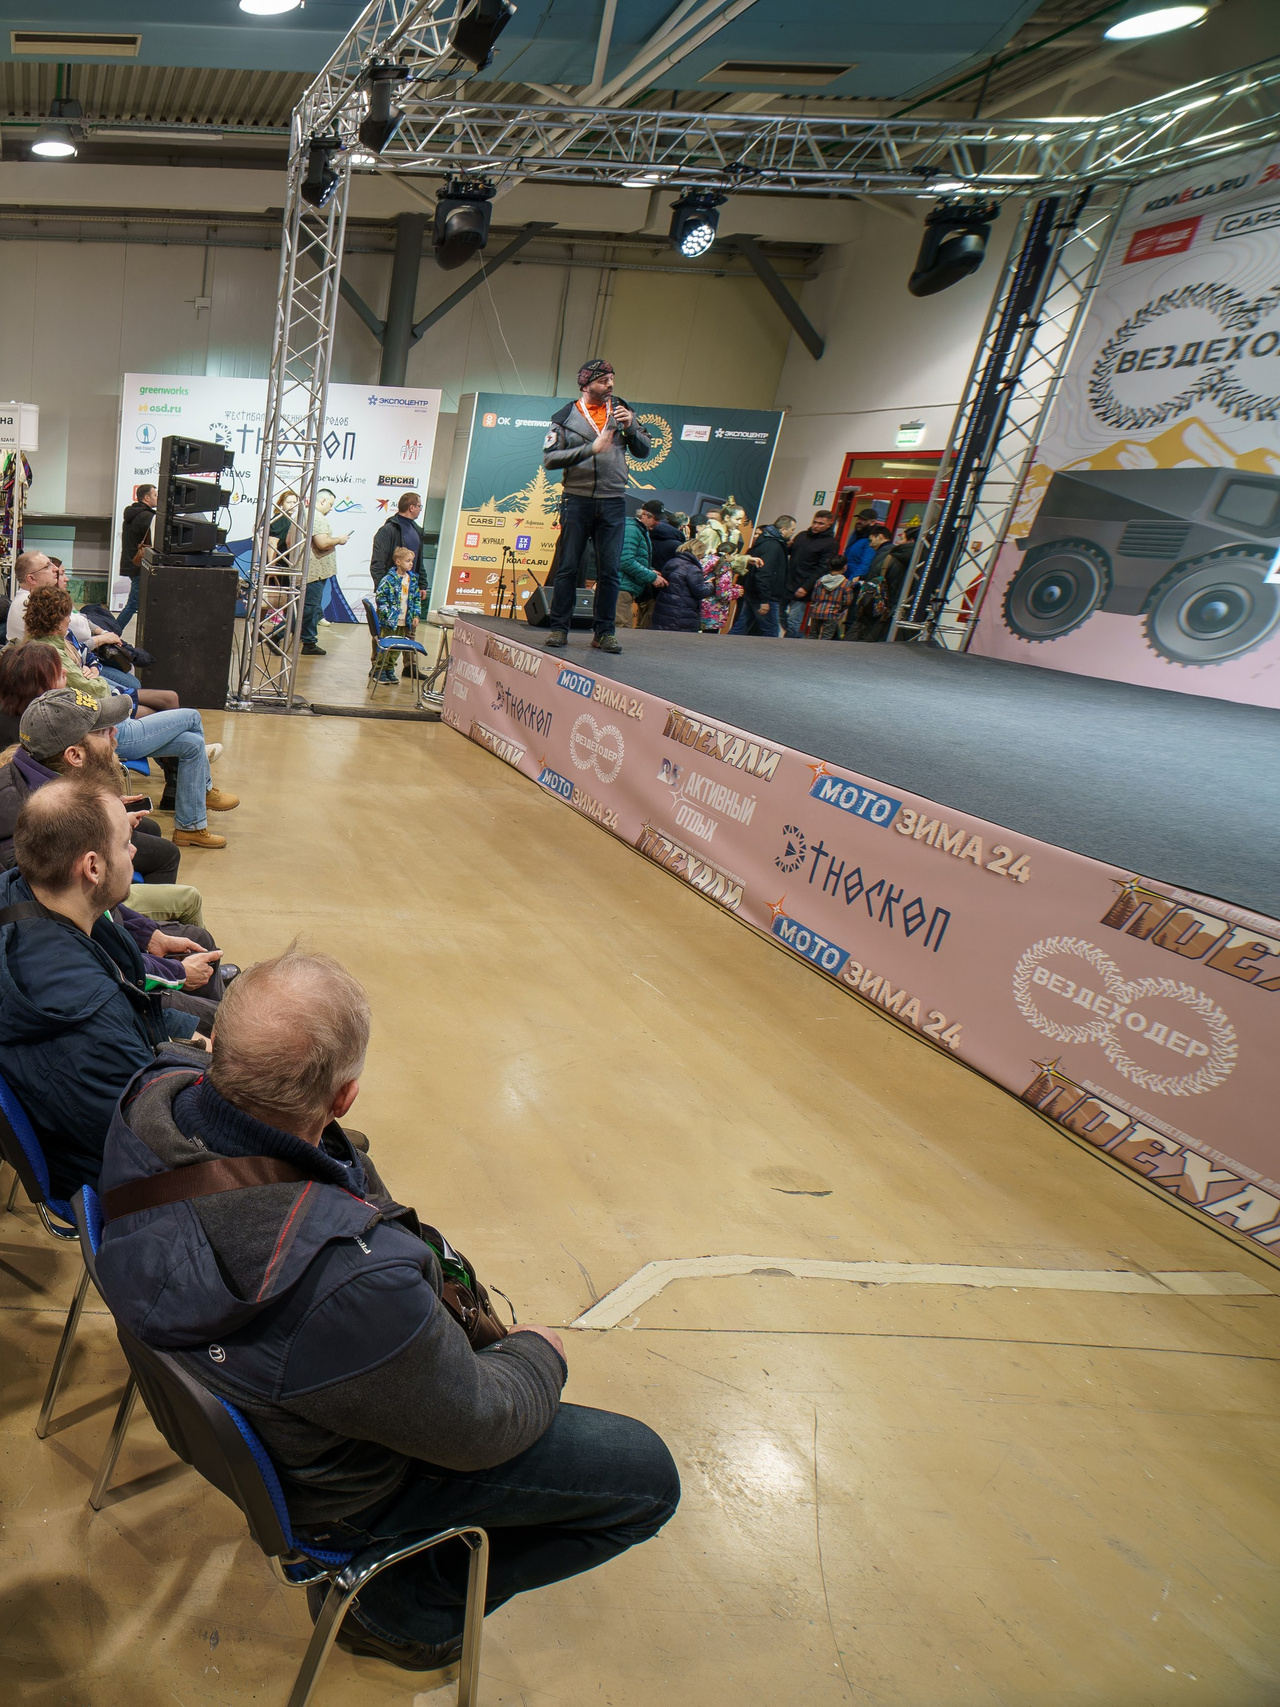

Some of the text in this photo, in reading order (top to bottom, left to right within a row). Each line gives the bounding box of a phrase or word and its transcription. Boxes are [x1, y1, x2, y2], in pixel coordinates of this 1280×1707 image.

[1115, 329, 1280, 374] ВЕЗДЕХО
[140, 386, 189, 395] greenworks
[149, 403, 182, 413] osd.ru
[379, 397, 429, 406] ЭКСПОЦЕНТР
[224, 410, 267, 422] ФЕСТИВАЛ
[515, 419, 553, 428] greenwor
[724, 430, 769, 438] ЭКСПОЦЕНТР
[378, 474, 415, 486] Версия
[456, 658, 487, 687] АКТИВНЫЙ
[484, 638, 543, 678] ПОЕХАЛИ
[592, 683, 627, 713] ЗИМА
[628, 699, 645, 721] 24
[469, 722, 526, 767] ПОЕХАЛИ
[575, 732, 619, 762] ВЕЗДЕХОДЕР
[663, 710, 783, 782] ПОЕХАЛИ
[572, 787, 603, 822] ЗИМА
[603, 808, 619, 831] 24
[684, 771, 757, 826] АКТИВНЫЙ
[675, 804, 719, 843] ОТДЫХ
[895, 808, 983, 866] ЗИМА
[986, 845, 1032, 884] 24
[634, 828, 745, 912] ПОЕХАЛИ
[774, 824, 952, 952] ЭТНОСКОП
[1100, 890, 1280, 992] ПОЕ
[842, 960, 922, 1027] ЗИМА
[922, 1010, 964, 1050] 24
[1031, 965, 1210, 1058] ВЕЗДЕХОДЕР
[1080, 1079, 1132, 1111] ВЫСТАВКА
[1128, 1104, 1204, 1150] ПУТЕШЕСТВИЙ
[1208, 1148, 1263, 1182] ТЕХНИКИ
